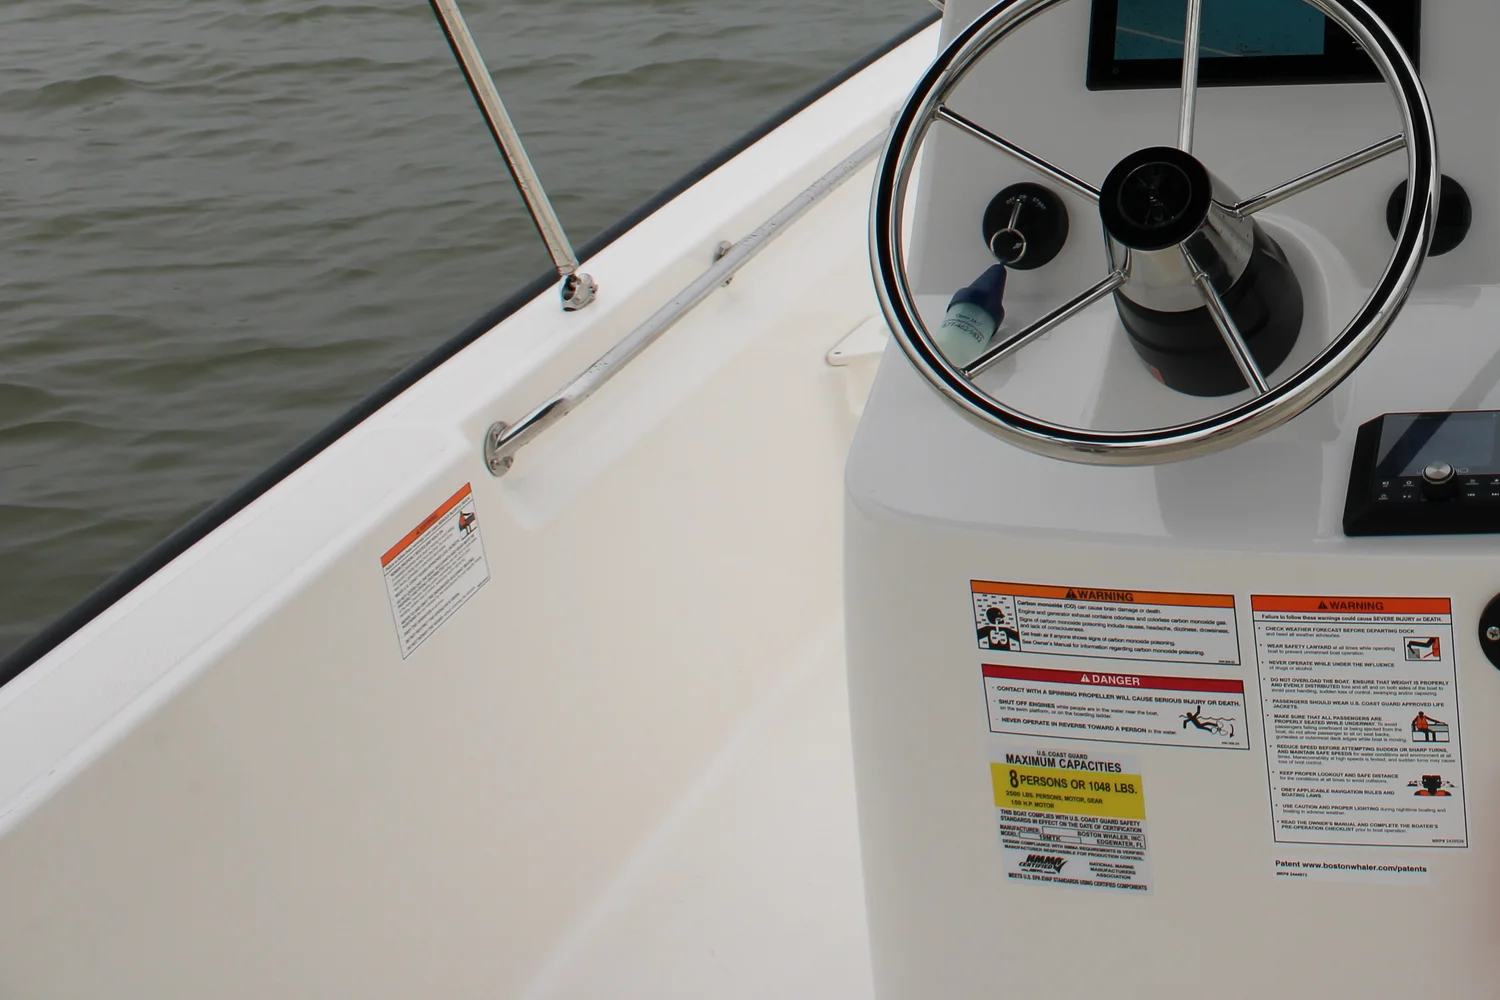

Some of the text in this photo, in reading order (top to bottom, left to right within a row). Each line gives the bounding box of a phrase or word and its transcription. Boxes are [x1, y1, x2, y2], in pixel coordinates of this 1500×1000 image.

[1077, 589, 1134, 602] WARNING
[1329, 602, 1384, 610] WARNING
[1092, 675, 1140, 686] DANGER
[1028, 701, 1055, 709] ENGINES
[1058, 721, 1086, 729] REVERSE
[1087, 723, 1114, 731] TOWARD
[1006, 754, 1122, 772] MAXIMUM CAPACITIES
[1009, 769, 1137, 794] 8 PERSONS OR 1048 LBS.
[1036, 793, 1063, 801] PERSONS,
[1064, 795, 1086, 803] MOTOR,
[1103, 833, 1130, 841] WHALER,
[1097, 839, 1135, 847] EDGEWATER,
[1275, 860, 1427, 873] Patent www.bostonwhaler.com/patents
